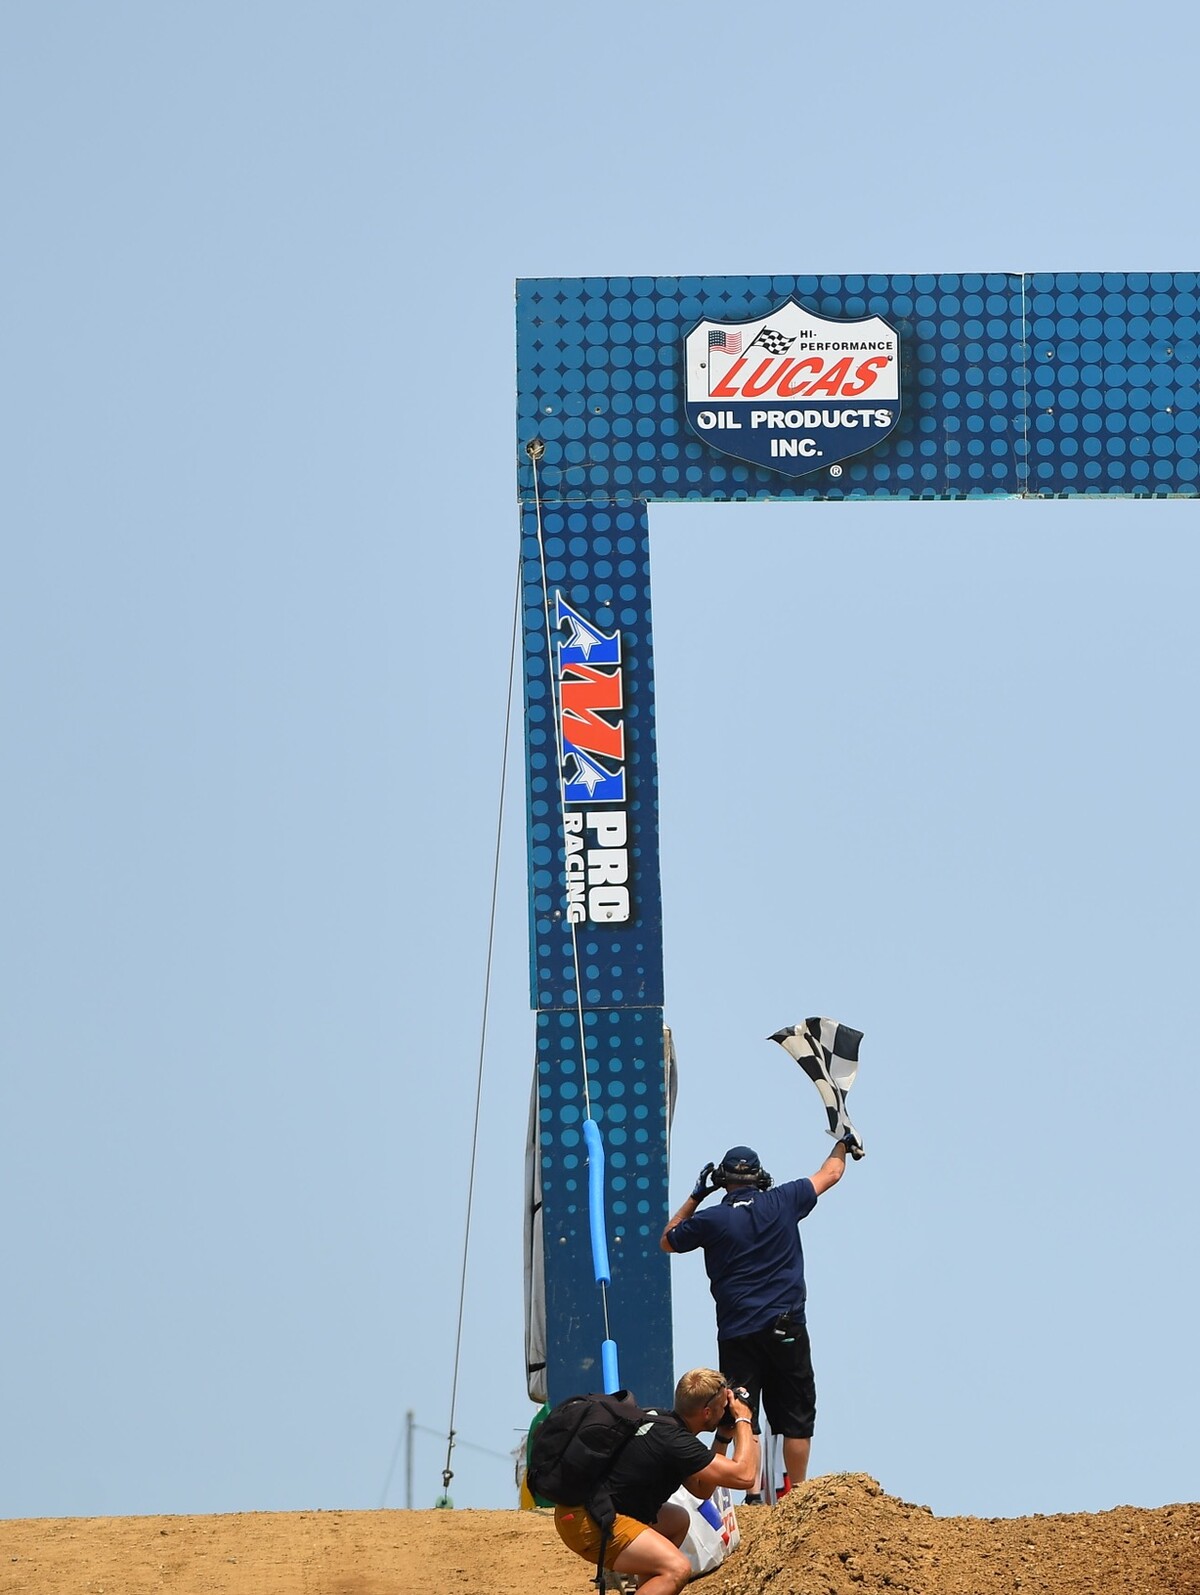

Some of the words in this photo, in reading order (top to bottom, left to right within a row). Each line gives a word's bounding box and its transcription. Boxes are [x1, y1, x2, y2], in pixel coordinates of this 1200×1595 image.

[800, 330, 817, 338] HI-
[800, 341, 893, 351] PERFORMANCE
[708, 356, 889, 398] LUCAS
[697, 411, 742, 430] OIL
[751, 409, 891, 429] PRODUCTS
[770, 438, 823, 457] INC.
[563, 812, 587, 924] RACING
[586, 810, 630, 923] PRO
